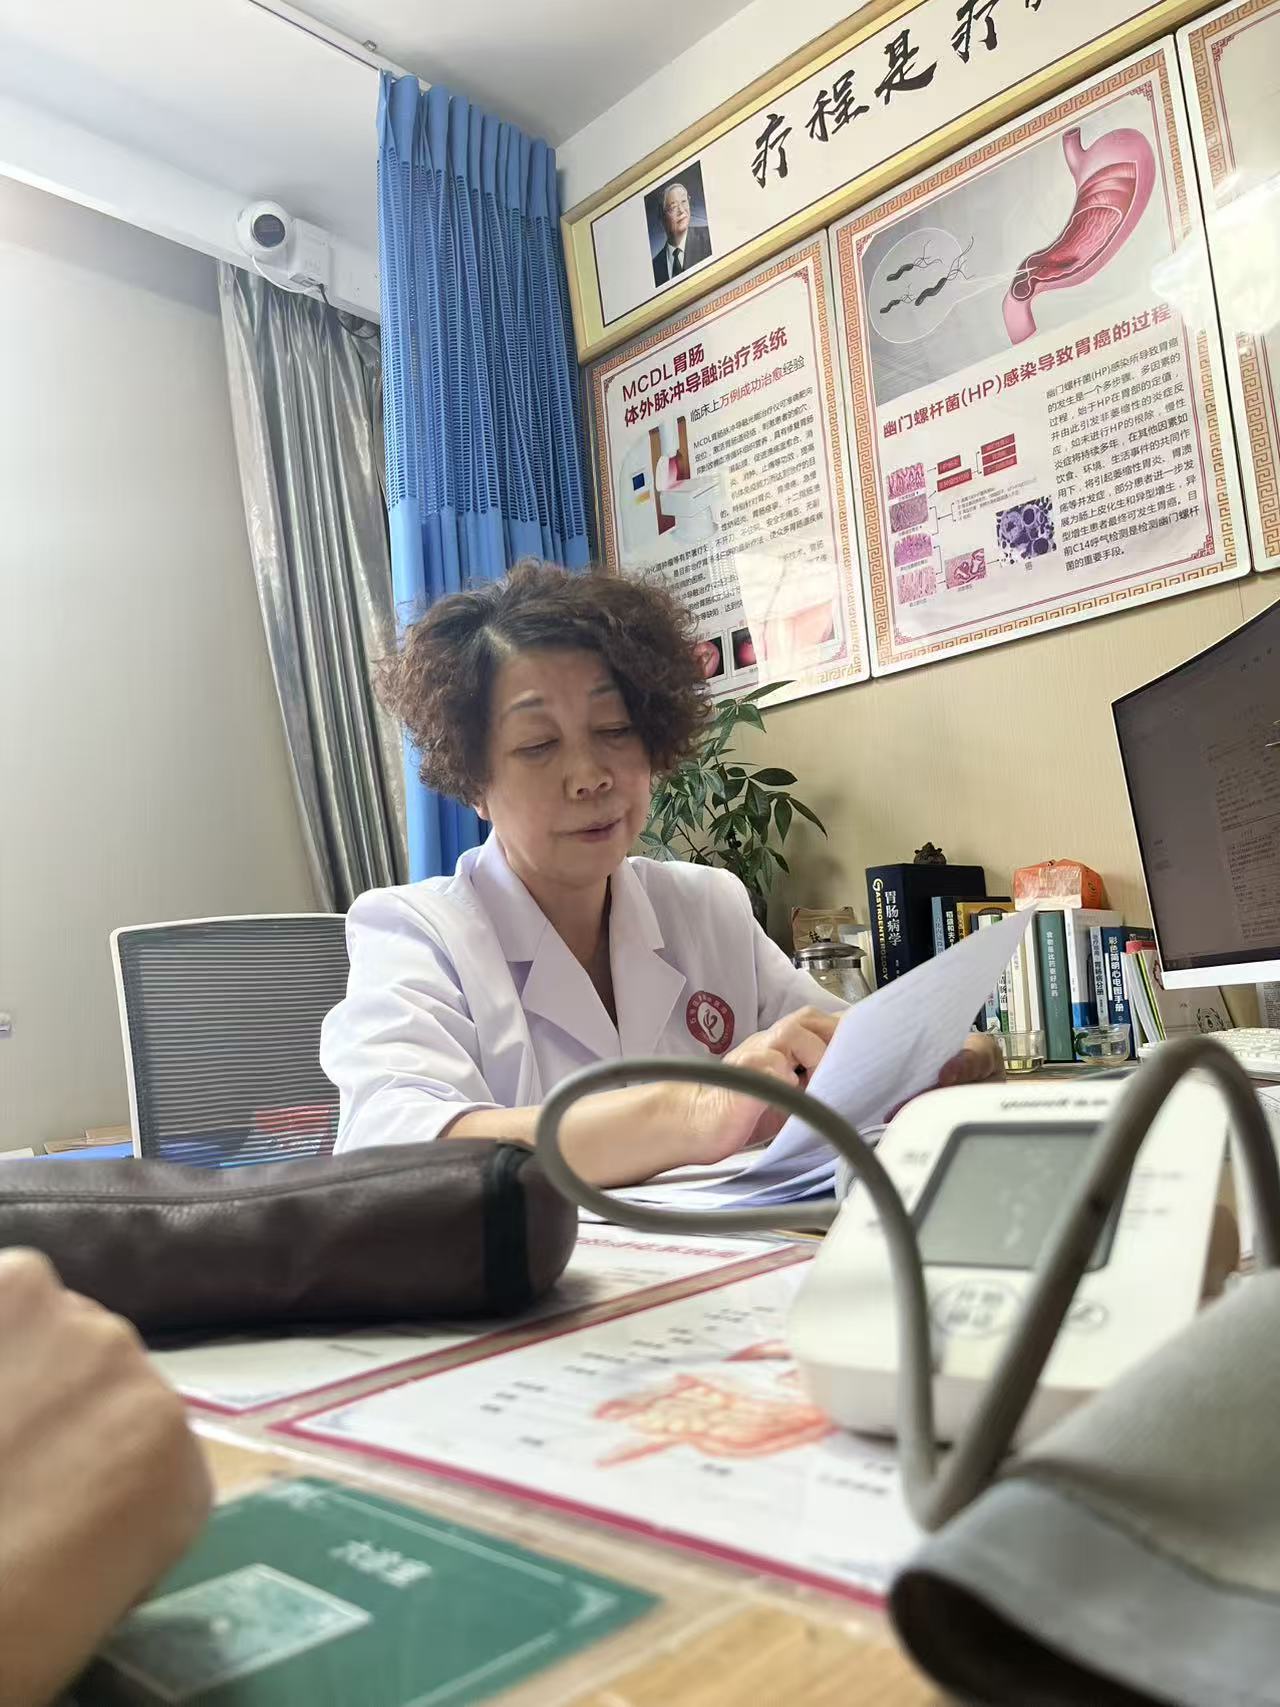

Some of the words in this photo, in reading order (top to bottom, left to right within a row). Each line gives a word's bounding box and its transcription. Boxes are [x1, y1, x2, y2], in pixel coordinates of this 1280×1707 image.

[622, 344, 704, 400] MCDL胃肠
[623, 327, 787, 427] 体外脉冲导融治疗系统
[690, 356, 806, 423] 临床上万例成功治愈经验
[882, 302, 1173, 439] 幽门螺杆菌(HP)感染导致胃癌的过程
[1065, 544, 1125, 571] 菌的重要手段。
[872, 878, 888, 980] GASTROENTEROLOGY
[884, 890, 902, 947] 胃肠病学
[1109, 936, 1129, 1013] 彩色简明心电图手册
